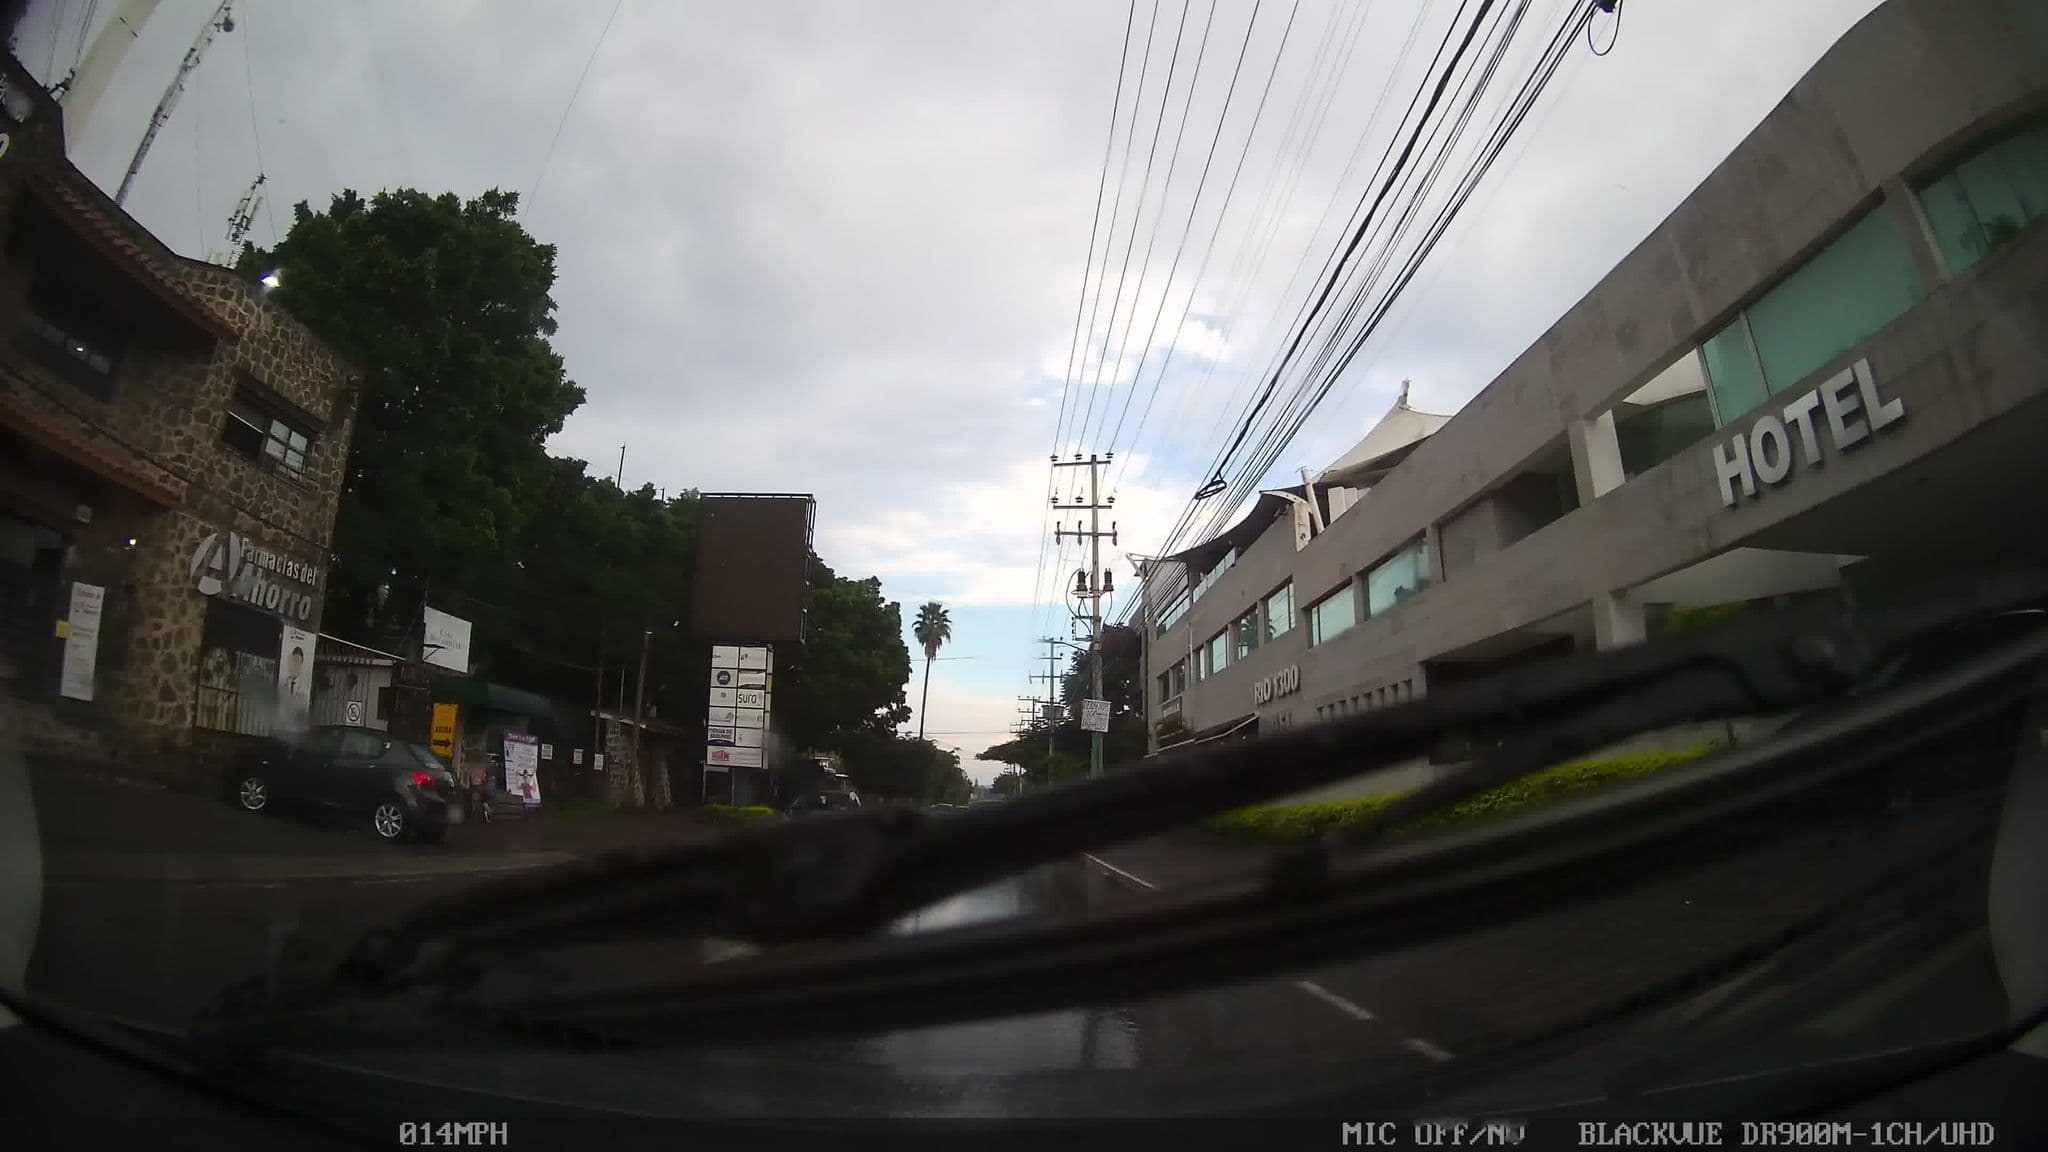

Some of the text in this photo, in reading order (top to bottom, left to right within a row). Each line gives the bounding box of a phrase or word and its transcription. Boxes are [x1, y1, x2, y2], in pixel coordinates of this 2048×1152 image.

[1713, 357, 1904, 507] HOTEL
[240, 538, 317, 585] Farmacias del
[237, 563, 311, 621] Ahorro
[738, 693, 757, 704] sura
[1254, 664, 1298, 704] RIO 1300
